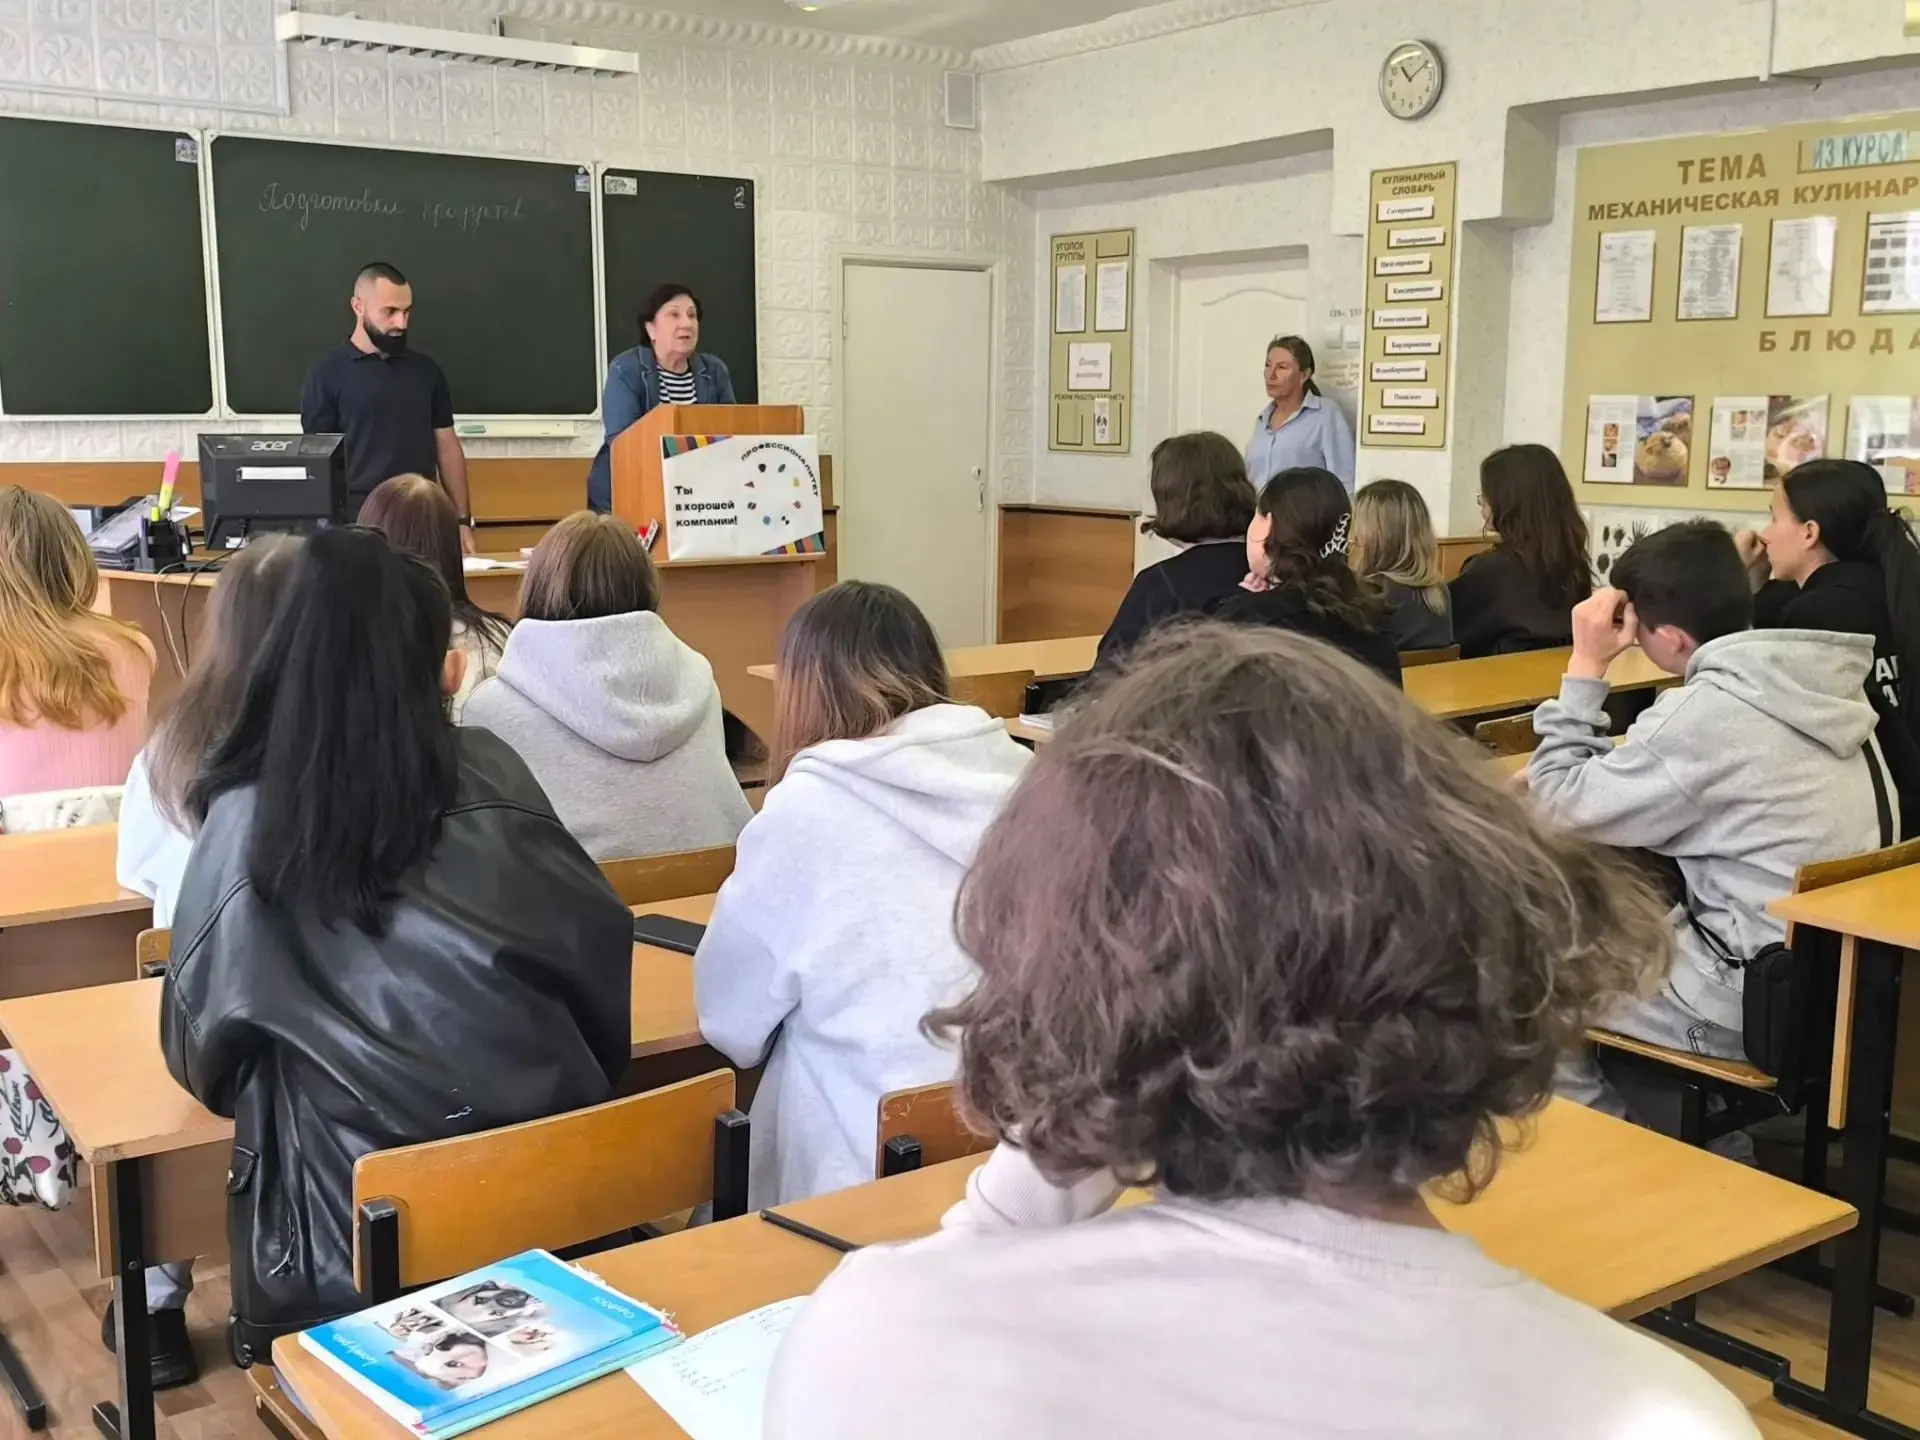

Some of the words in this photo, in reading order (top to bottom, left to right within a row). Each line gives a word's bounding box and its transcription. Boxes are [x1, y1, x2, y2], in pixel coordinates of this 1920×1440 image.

[1678, 153, 1767, 185] ТЕМА
[1813, 138, 1835, 169] ИЗ
[1382, 171, 1446, 184] КУЛИНАРНЫЙ
[1392, 184, 1435, 196] СЛОВАРЬ
[1588, 189, 1779, 221] МЕХАНИЧЕСКАЯ
[1794, 176, 1920, 205] КУЛИНАР
[251, 440, 293, 451] acer
[741, 442, 819, 497] ПРОФЕССИОНАЛИТЕТ
[674, 485, 693, 496] Ты
[675, 503, 682, 511] в
[684, 500, 735, 513] хорошей
[676, 515, 738, 527] компании!
